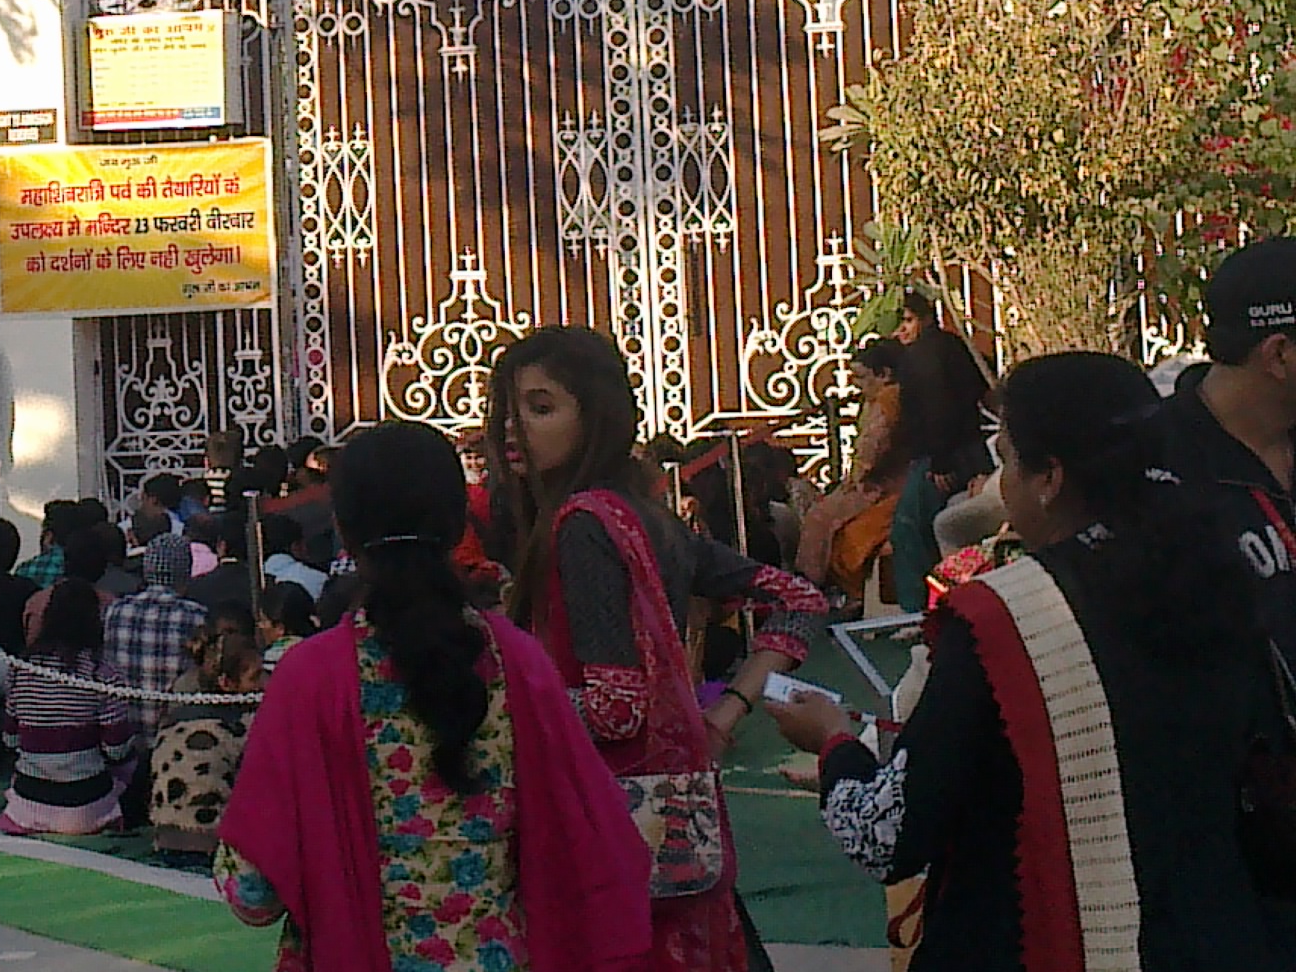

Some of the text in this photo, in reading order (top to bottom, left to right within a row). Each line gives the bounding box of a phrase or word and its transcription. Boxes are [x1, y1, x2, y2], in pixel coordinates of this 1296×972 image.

[20, 178, 105, 207] महाशिवरात्रि
[110, 176, 133, 201] पर्व
[136, 175, 157, 199] की
[160, 172, 222, 198] तैयारियों
[135, 217, 149, 234] 23
[153, 207, 201, 233] फरवरी
[205, 206, 255, 230] वीरवार
[26, 250, 46, 273] को
[49, 248, 94, 271] दर्शनों
[96, 247, 113, 270] के
[116, 245, 146, 270] लिए
[1248, 302, 1292, 318] GURU
